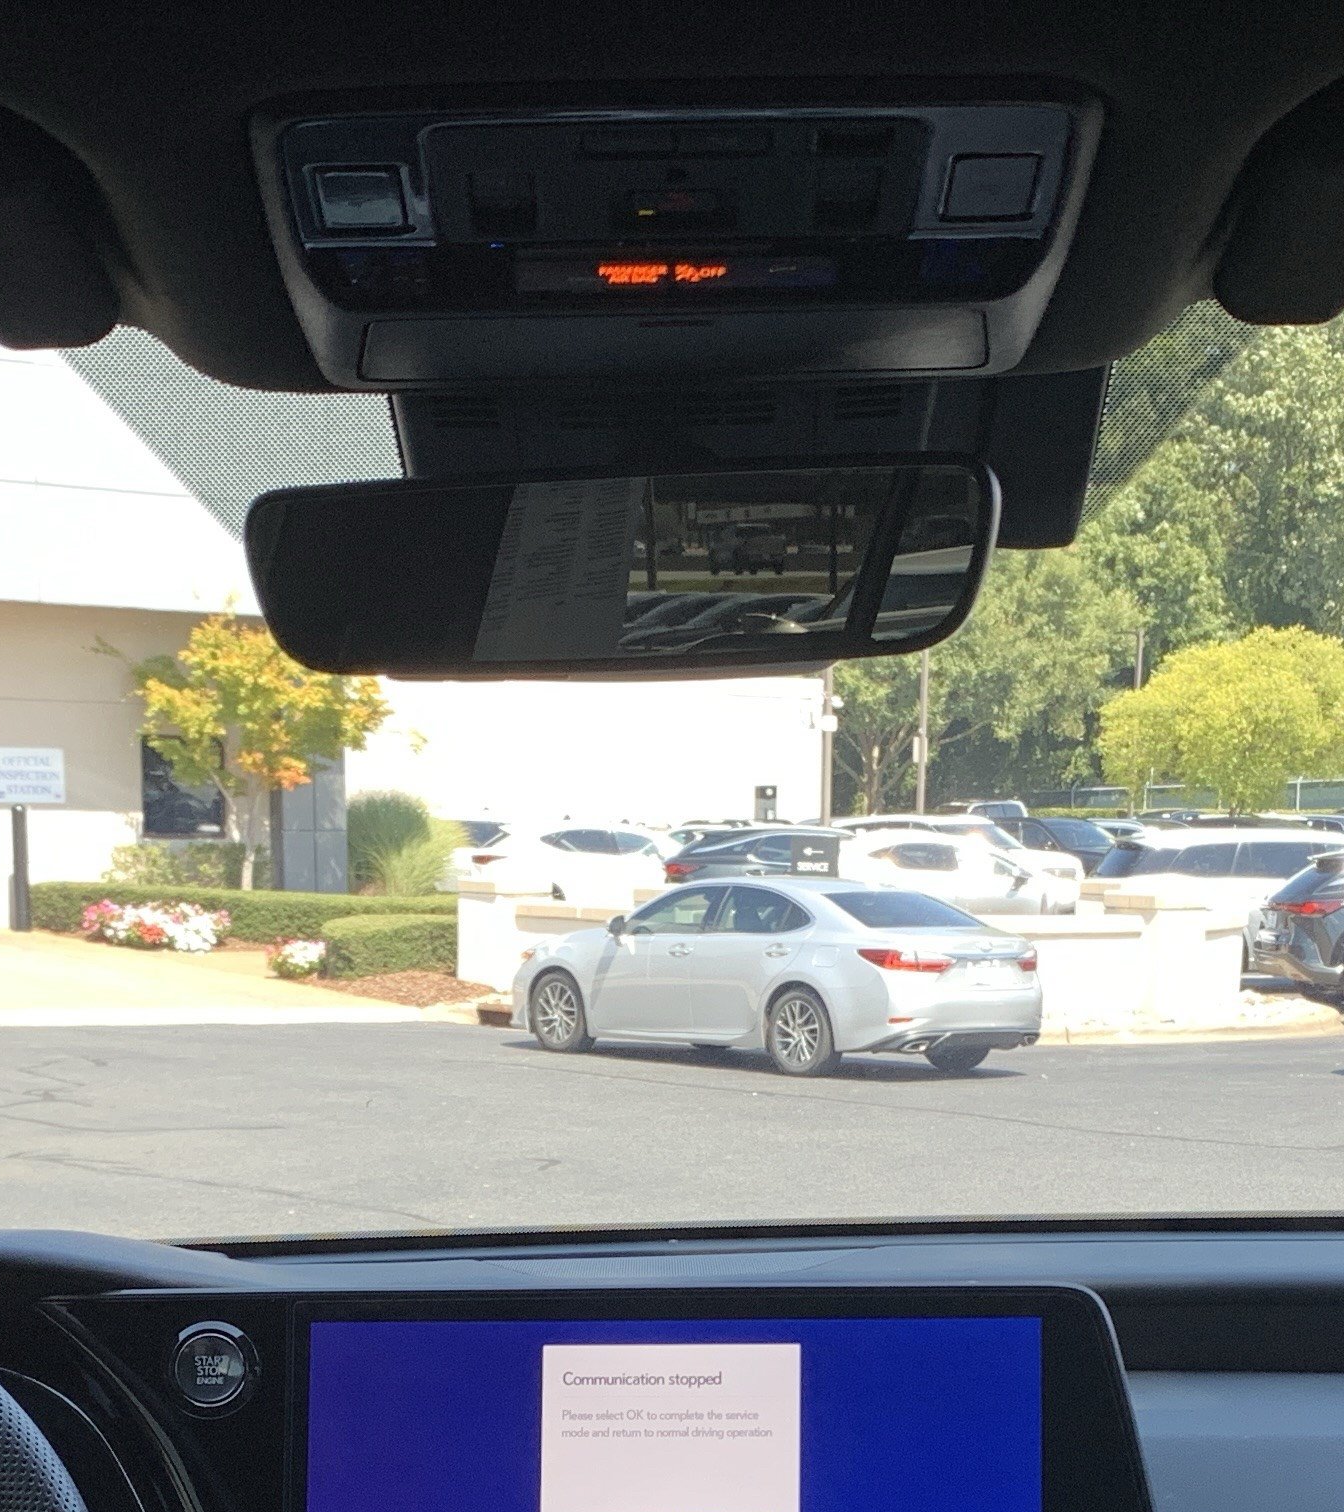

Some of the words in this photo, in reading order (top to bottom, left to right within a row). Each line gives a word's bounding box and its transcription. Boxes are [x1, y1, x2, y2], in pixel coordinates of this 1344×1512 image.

[6, 784, 51, 795] STATION
[796, 861, 829, 872] SERVICE
[197, 1376, 224, 1385] ENGINE
[562, 1371, 665, 1386] Communication
[668, 1371, 722, 1388] stopped
[562, 1409, 593, 1421] Please
[596, 1409, 624, 1421] select
[626, 1409, 644, 1420] OK
[646, 1410, 657, 1421] to
[659, 1410, 704, 1423] complete
[707, 1410, 723, 1421] the
[725, 1410, 759, 1421] service
[561, 1427, 590, 1438] mode
[592, 1427, 610, 1438] and
[612, 1428, 642, 1438] return
[644, 1429, 655, 1438] to
[656, 1427, 690, 1438] normal
[691, 1427, 724, 1440] driving
[726, 1427, 773, 1441] operation
